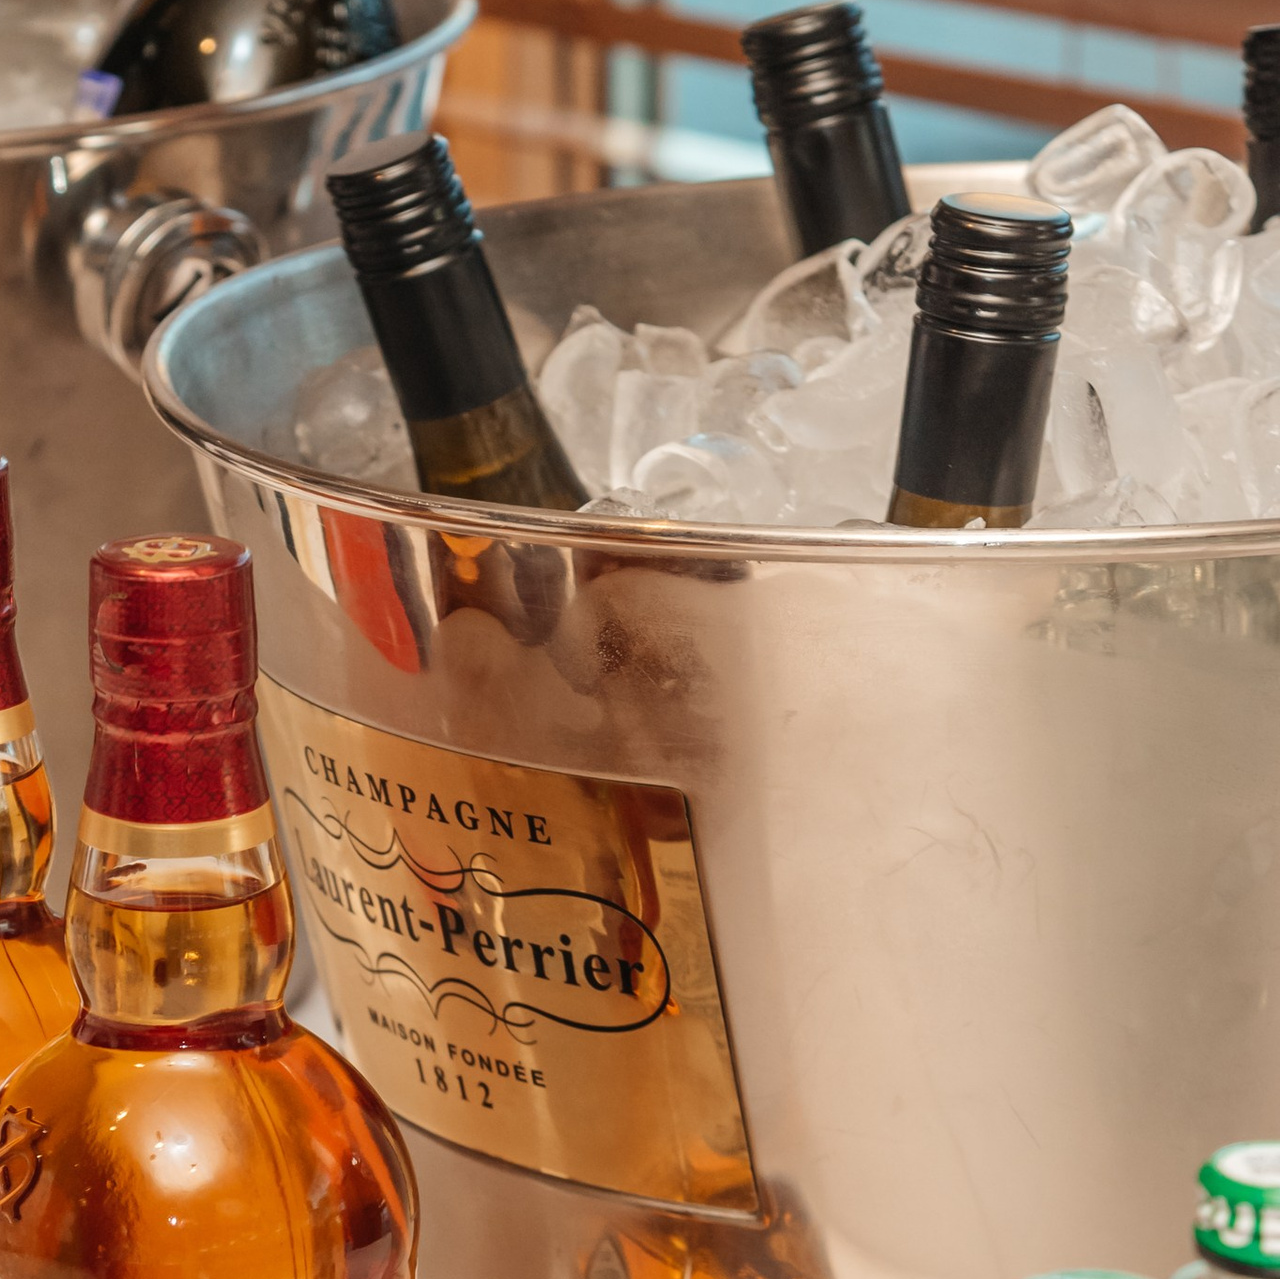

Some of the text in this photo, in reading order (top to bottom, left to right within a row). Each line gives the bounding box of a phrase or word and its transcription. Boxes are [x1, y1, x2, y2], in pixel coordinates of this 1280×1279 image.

[303, 744, 552, 846] CHAMPAGNE
[294, 827, 645, 996] Laurent-Perrier
[367, 1006, 547, 1089] MAISON FONDÉE
[414, 1057, 495, 1110] 1812
